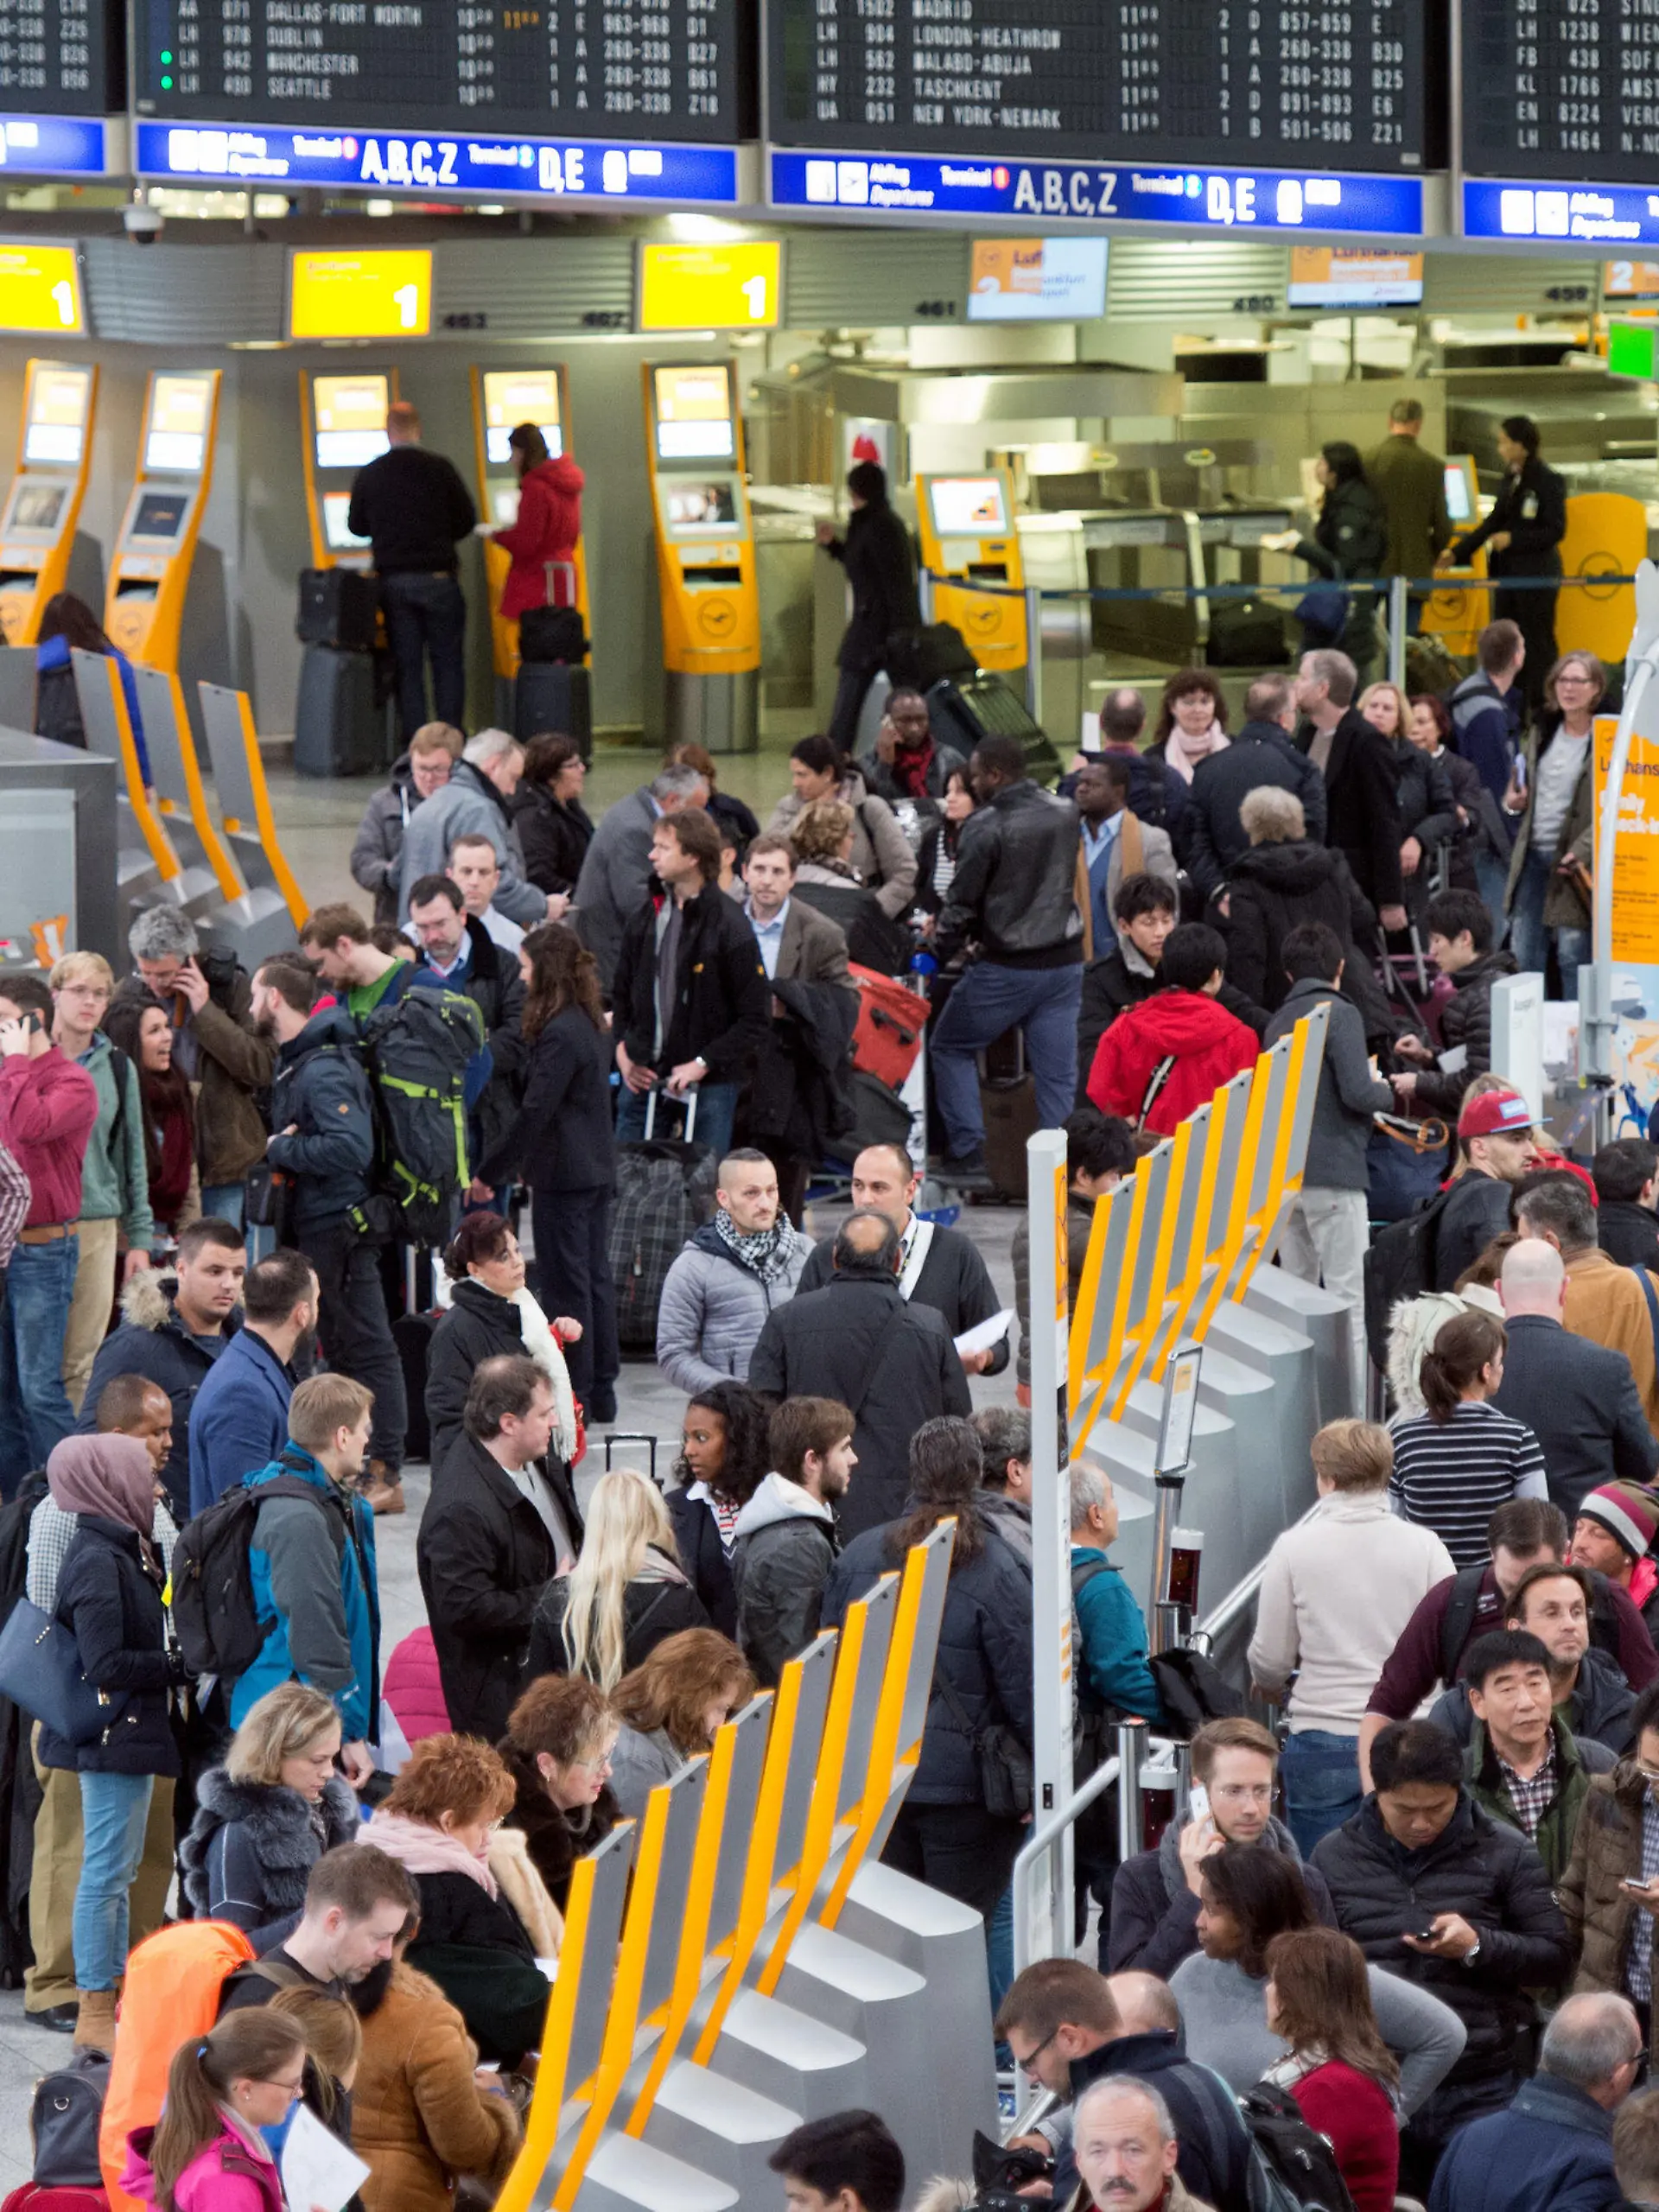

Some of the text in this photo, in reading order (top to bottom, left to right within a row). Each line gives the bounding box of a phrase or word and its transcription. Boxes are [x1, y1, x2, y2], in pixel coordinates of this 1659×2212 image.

[912, 0, 972, 21] MADRID
[1218, 9, 1230, 30] 2
[1371, 14, 1382, 35] E
[1516, 19, 1538, 40] LH
[1560, 20, 1600, 42] 1238
[266, 25, 323, 48] DUBLIN
[575, 38, 588, 59] A
[817, 22, 838, 42] LH
[913, 24, 1062, 50] LONDON-HEATHROW
[1220, 36, 1229, 57] 1
[1249, 37, 1261, 58] A
[1280, 38, 1352, 61] 260-338
[1516, 45, 1538, 68] FB
[1568, 47, 1600, 70] 438
[267, 52, 359, 75] MANCHESTER
[575, 63, 588, 85] A
[817, 48, 839, 69] LH
[865, 49, 895, 72] 562
[913, 51, 1033, 75] MALABO-ABUJA
[1220, 63, 1229, 84] 1
[1249, 64, 1261, 85] A
[1280, 65, 1352, 89] 260-338
[1516, 73, 1538, 96] KL
[1560, 75, 1600, 98] 1766
[267, 76, 333, 100] SEATTLE
[575, 90, 588, 111] A
[865, 75, 896, 98] 232
[913, 77, 1002, 101] TASCHKENT
[1219, 89, 1230, 111] 2
[1372, 94, 1394, 118] E6
[865, 101, 895, 124] 051
[913, 104, 944, 124] NEW
[952, 105, 1062, 130] YORK-NEWARK
[1221, 116, 1230, 137] 1
[1281, 118, 1352, 143] 501-506
[1516, 100, 1539, 123] EN
[1559, 102, 1600, 124] 8224
[1517, 128, 1539, 150] LH
[1560, 130, 1600, 152] 1464
[360, 138, 459, 186] A,B,C,Z
[537, 147, 585, 194] D,E
[940, 164, 993, 188] Terminal
[1014, 168, 1119, 216] A,B,C,Z
[1132, 174, 1184, 196] Terminal
[1207, 176, 1256, 226] D,E
[1610, 260, 1634, 291] 2
[51, 279, 75, 326] 1
[393, 283, 418, 328] 1
[741, 275, 766, 319] 1
